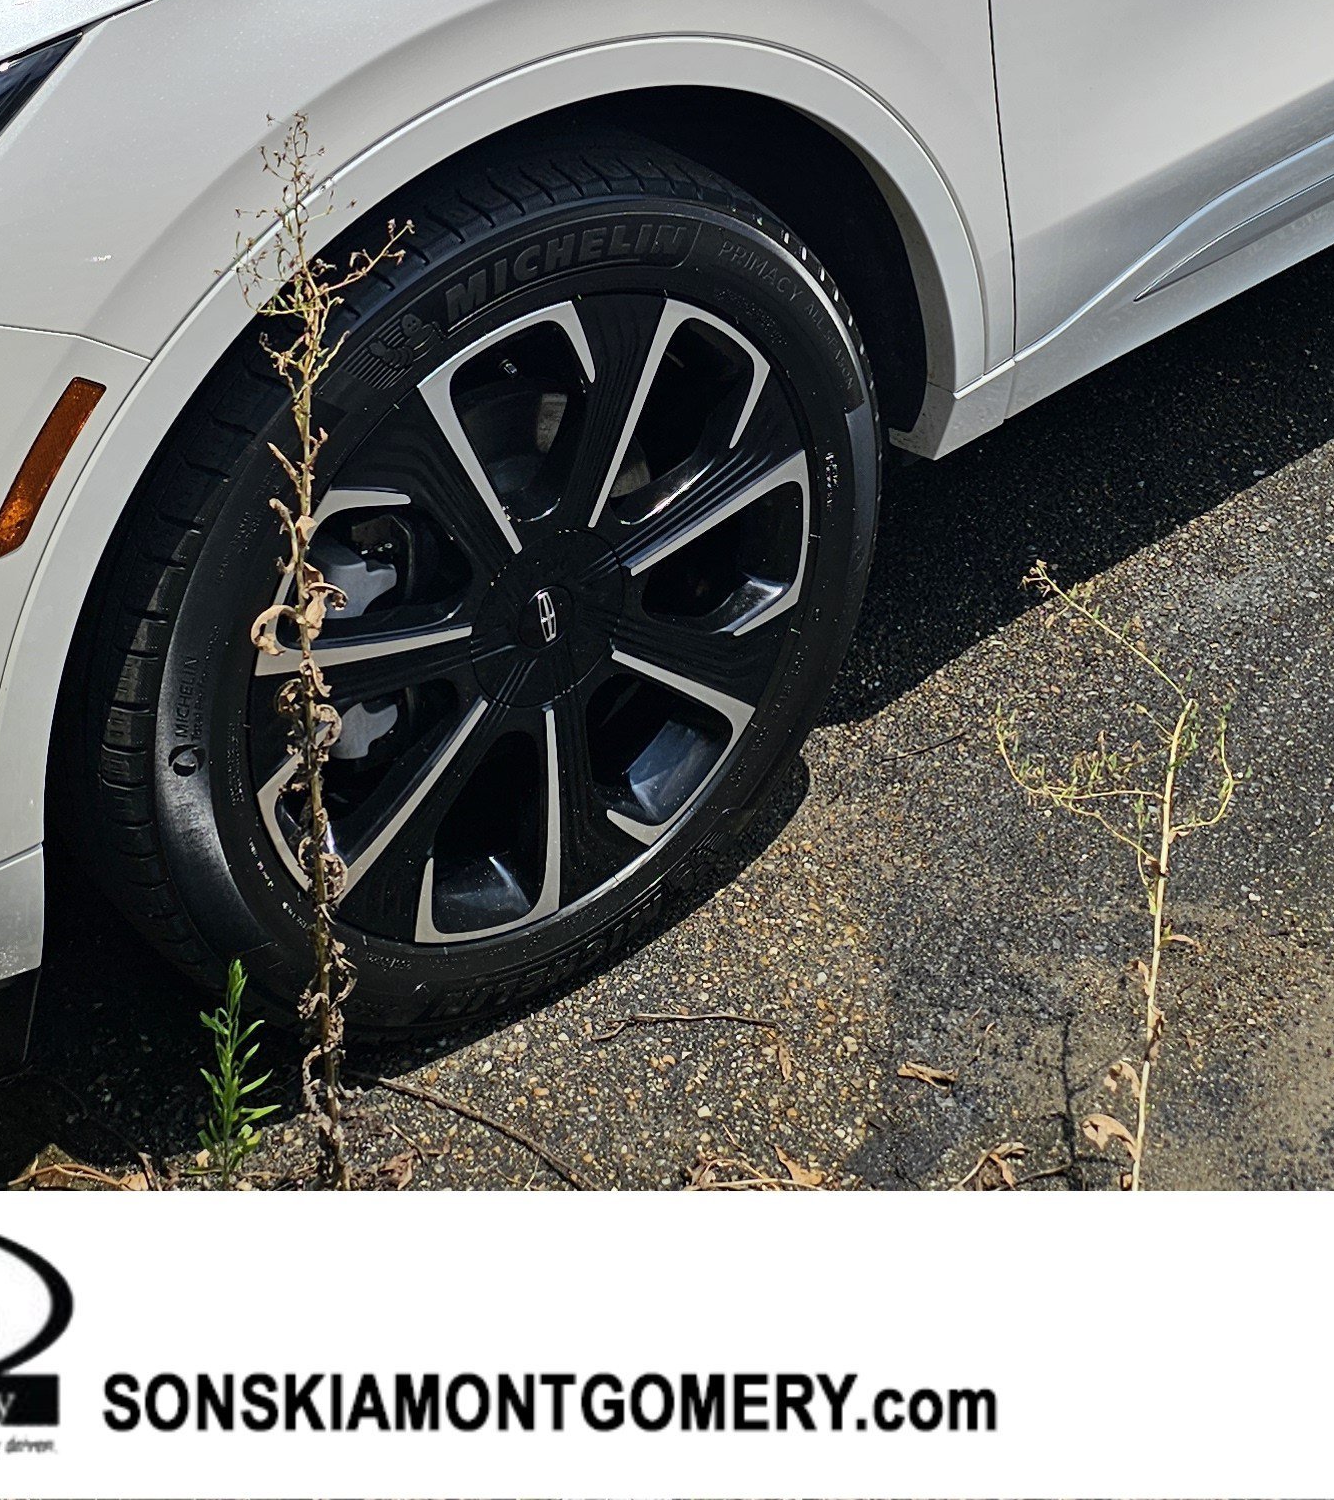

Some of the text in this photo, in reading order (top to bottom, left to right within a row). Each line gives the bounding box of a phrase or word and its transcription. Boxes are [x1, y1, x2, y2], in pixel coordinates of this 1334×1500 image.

[444, 223, 691, 322] MICHELIN
[718, 240, 803, 303] PRIMACY
[804, 301, 824, 331] ALL
[175, 656, 199, 739] MICHELIN
